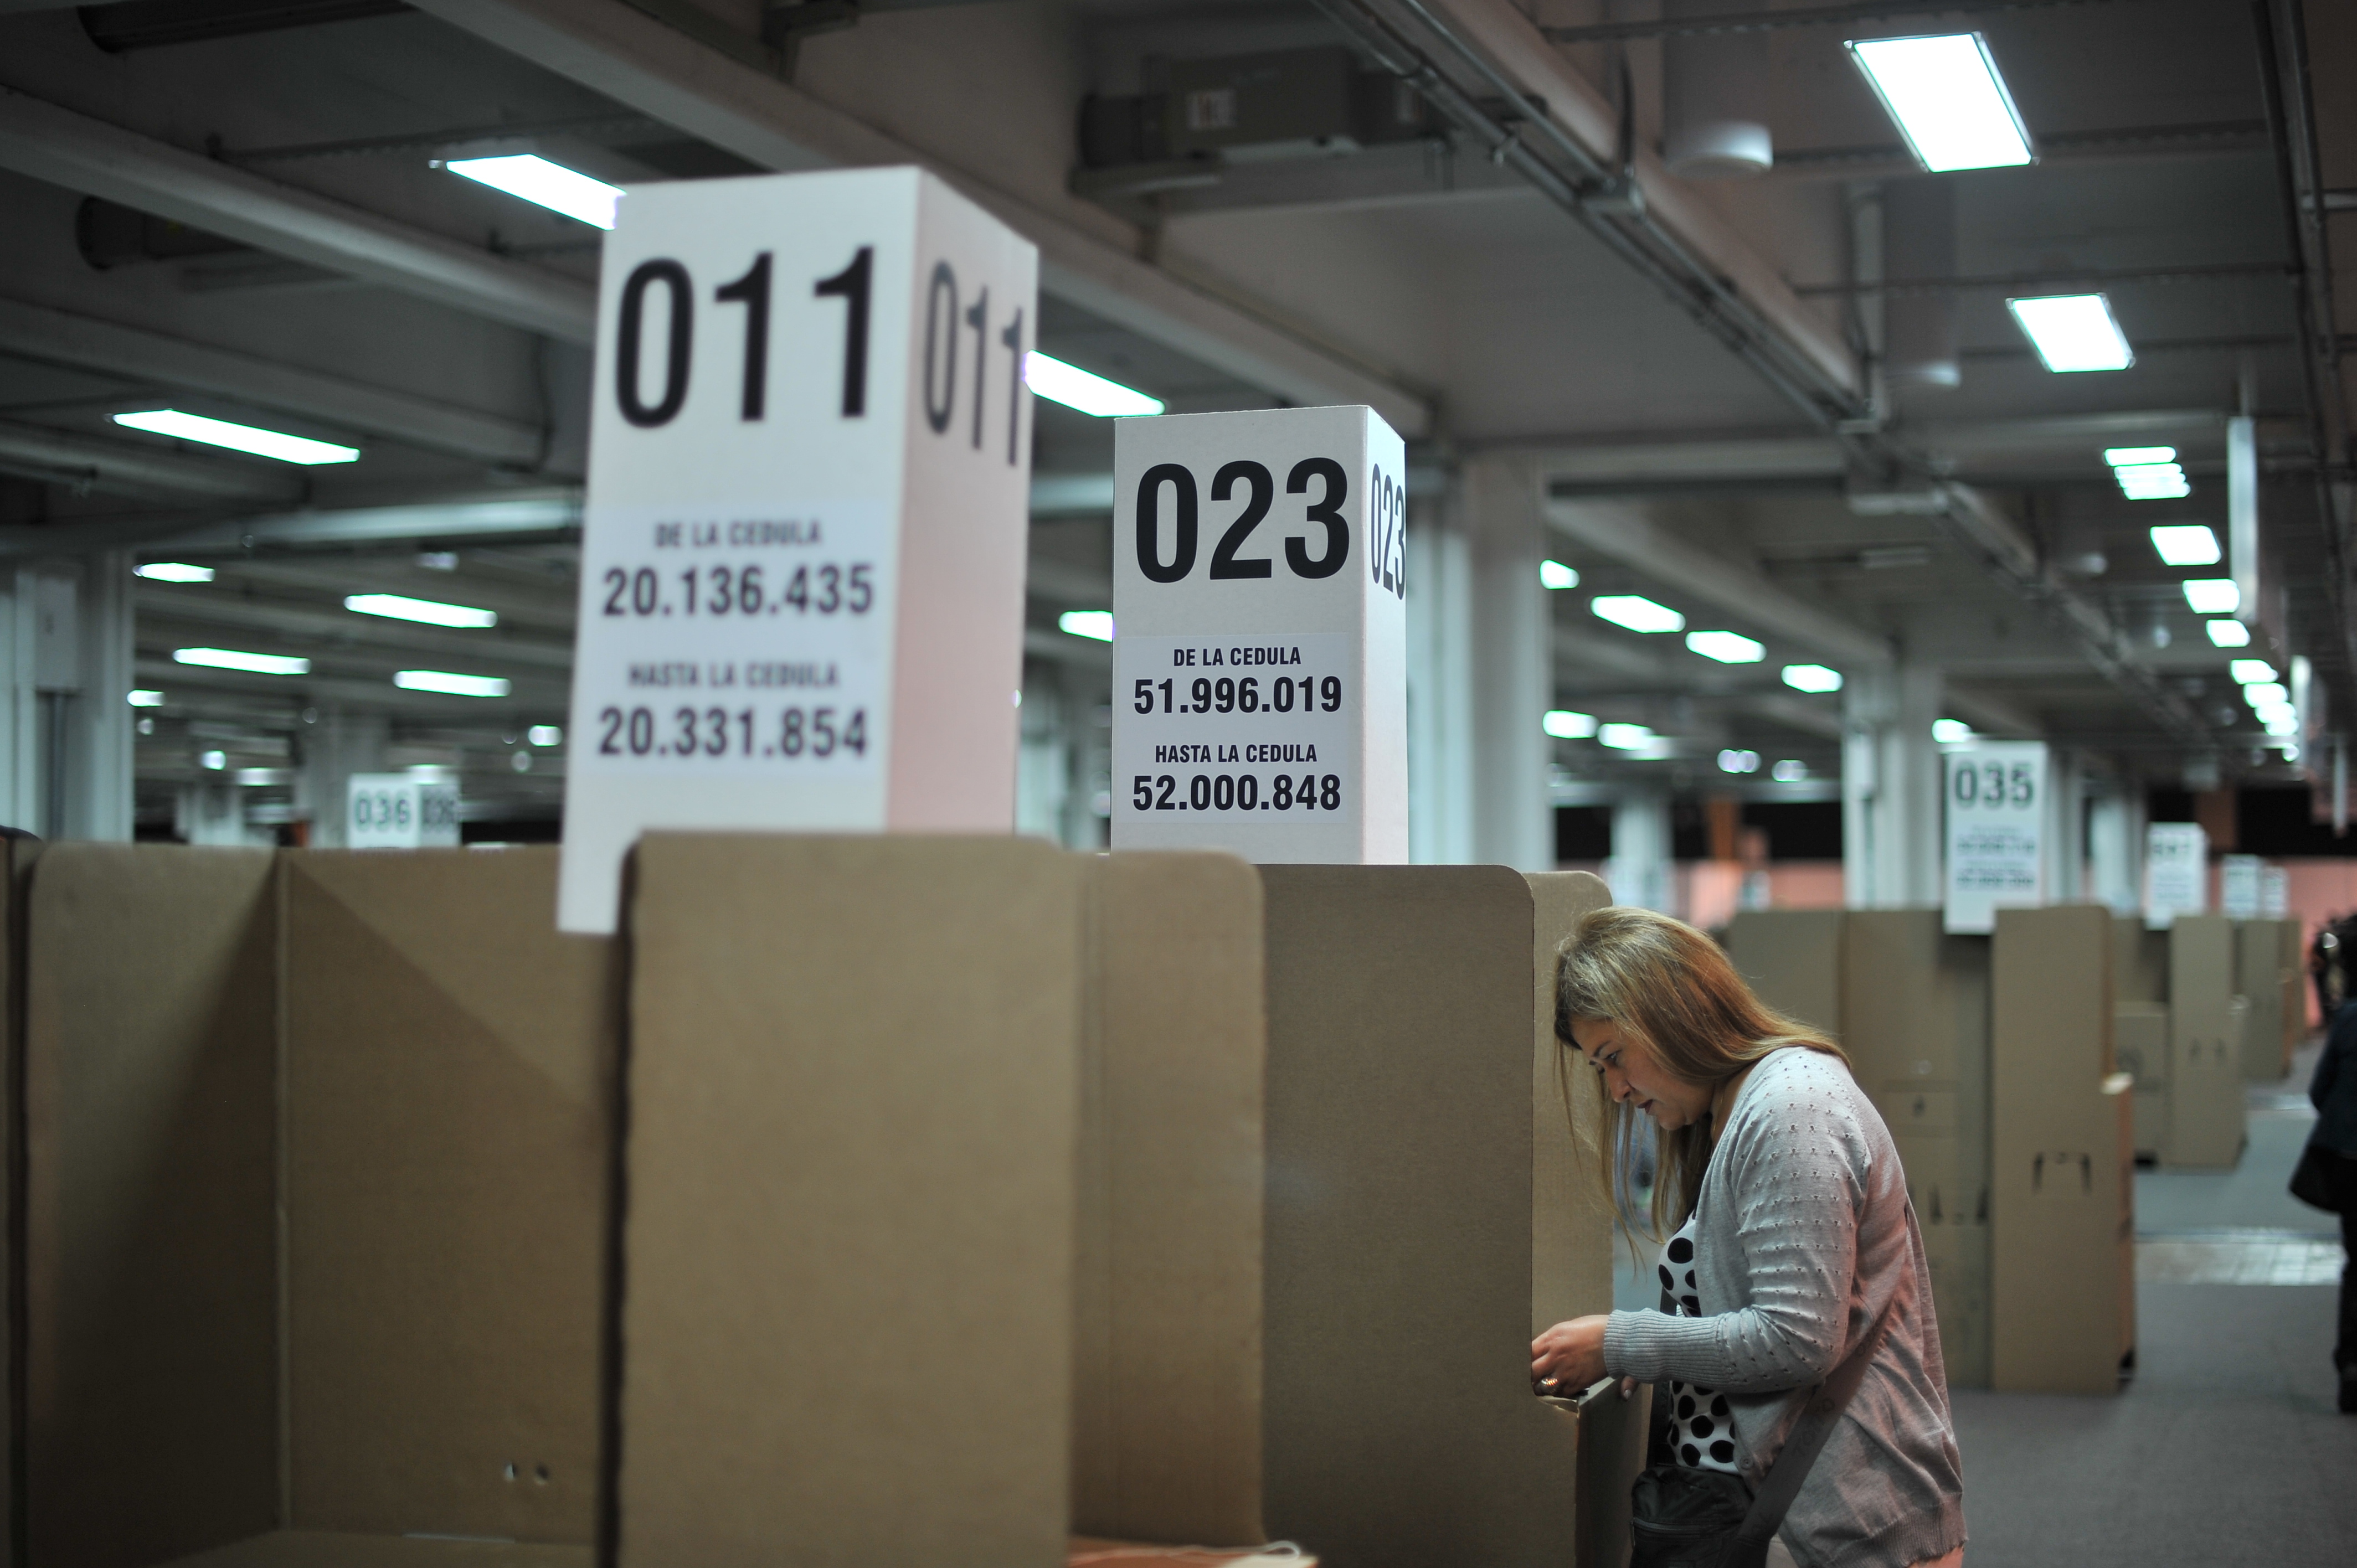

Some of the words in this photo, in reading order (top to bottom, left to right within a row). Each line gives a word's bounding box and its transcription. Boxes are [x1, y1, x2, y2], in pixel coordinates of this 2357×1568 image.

[615, 245, 874, 429] 011
[923, 260, 1022, 466] 011
[655, 522, 681, 548] DE
[692, 522, 718, 546] LA
[729, 519, 821, 545] CEDULA
[1136, 457, 1350, 584] 023
[1371, 463, 1406, 600] 023
[603, 561, 874, 616] 20.136.435
[629, 662, 699, 688] HASTA
[708, 662, 736, 688] LA
[746, 662, 838, 688] CEDULA
[1174, 649, 1196, 666] DE
[1203, 648, 1223, 666] LA
[1230, 647, 1301, 666] CEDULA
[1134, 676, 1342, 714] 51.996.019
[598, 706, 867, 757] 20.331.854
[1155, 745, 1212, 763] HASTA
[1218, 745, 1239, 762] LA
[1246, 744, 1317, 762] CEDULA
[1133, 774, 1341, 811] 52.000.848
[1955, 759, 2035, 809] 035
[354, 790, 411, 831] 036
